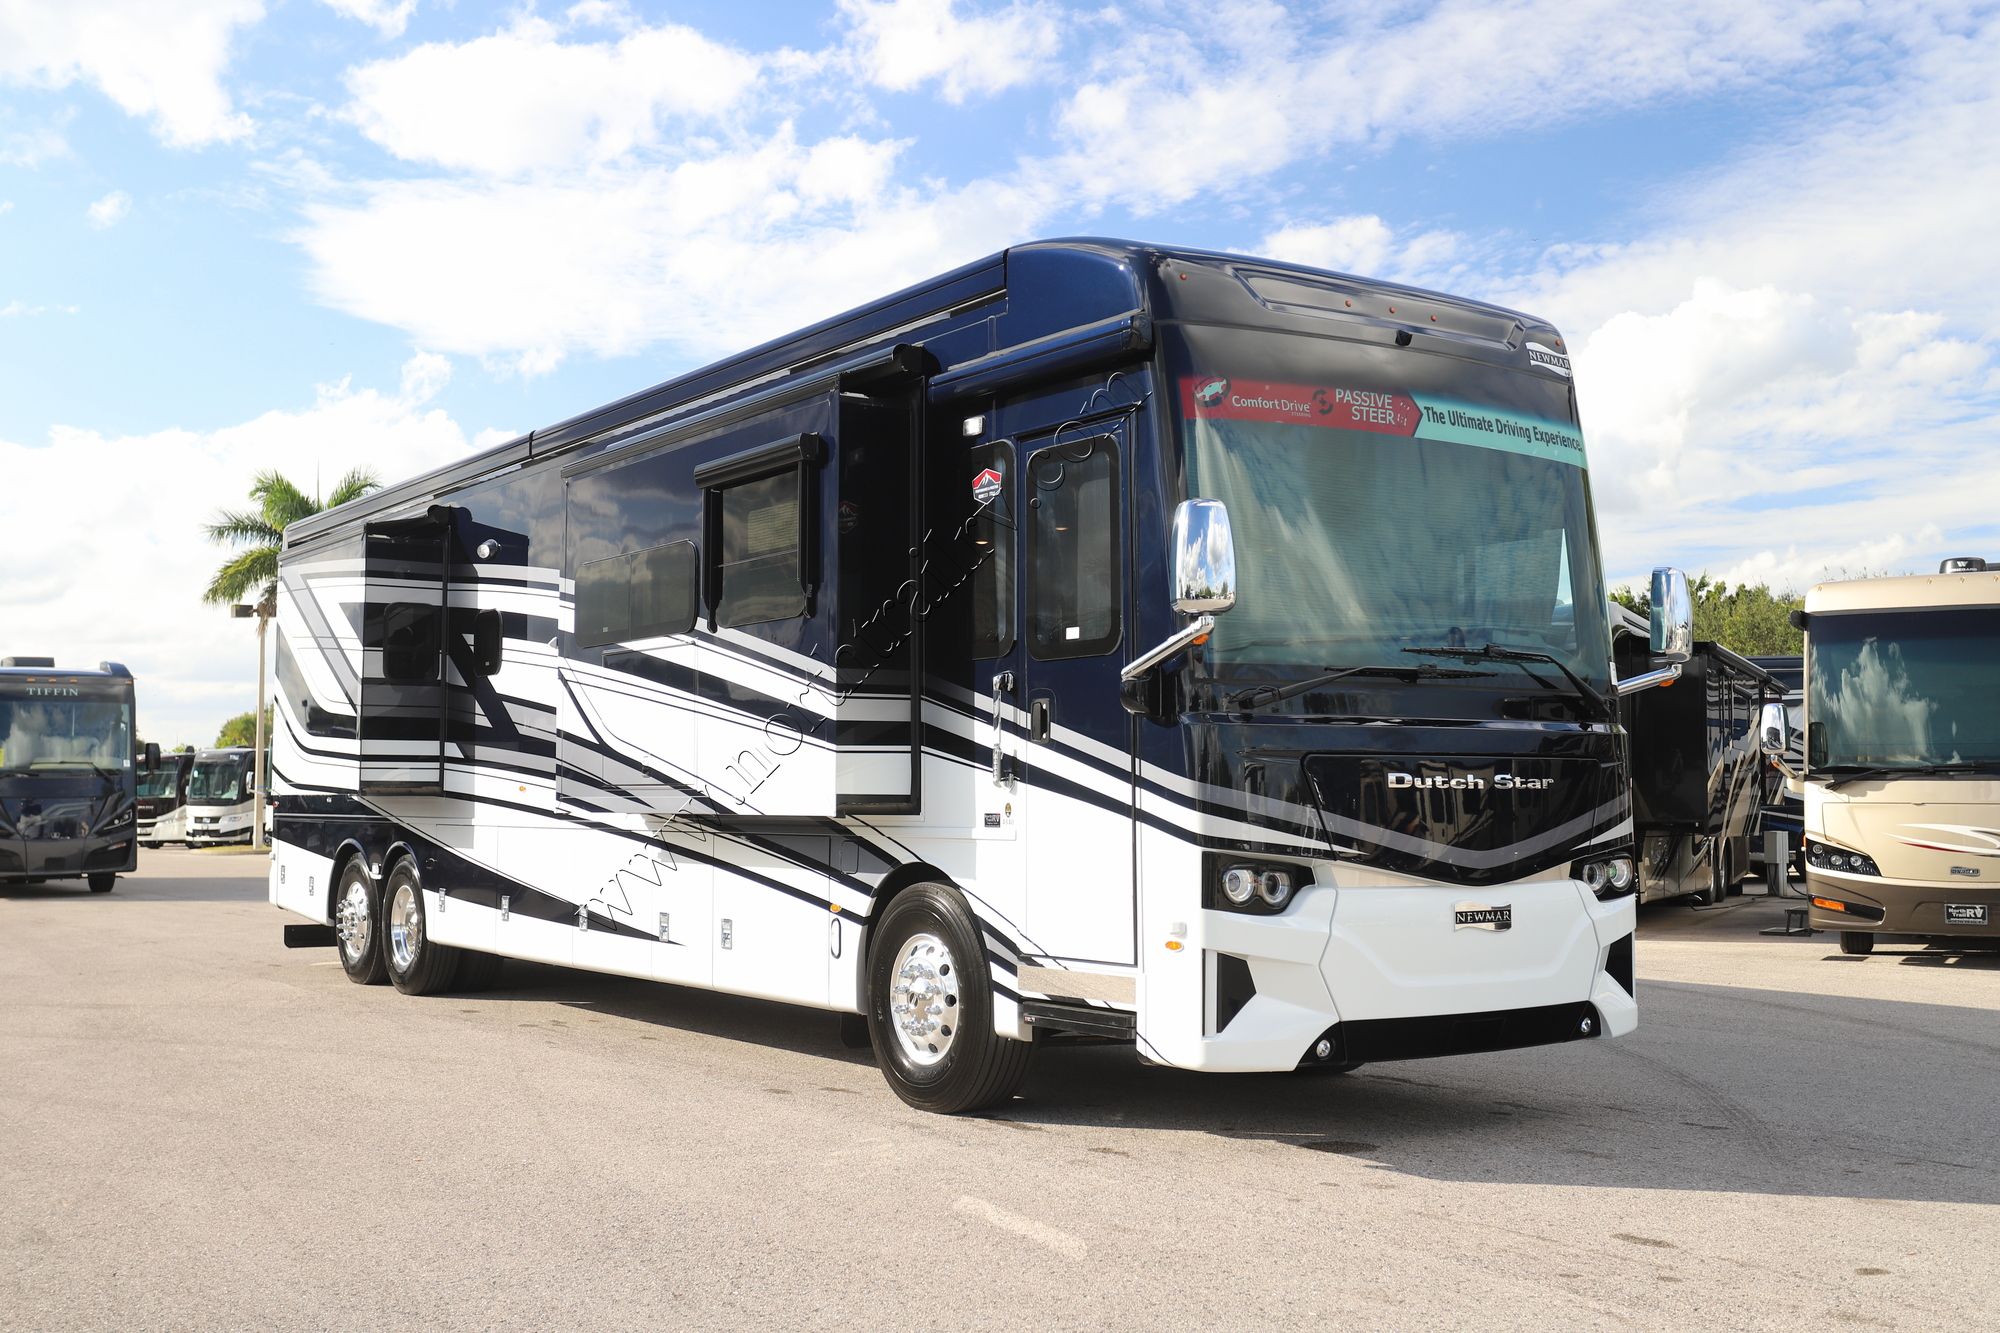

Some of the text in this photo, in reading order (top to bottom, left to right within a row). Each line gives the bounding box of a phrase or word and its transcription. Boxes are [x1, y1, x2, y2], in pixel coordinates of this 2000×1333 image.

[1529, 350, 1570, 369] NEWMAR
[1231, 395, 1281, 410] Comfort
[1335, 388, 1393, 409] PASSIVE
[1351, 406, 1396, 425] STEER
[1423, 406, 1446, 425] The
[1448, 410, 1494, 433] Ultimate
[1495, 418, 1532, 443] Driving
[26, 687, 79, 696] TIFFIN
[1387, 772, 1555, 790] Dutch Star
[1455, 910, 1511, 924] NEWMAR
[1967, 909, 1983, 917] RV
